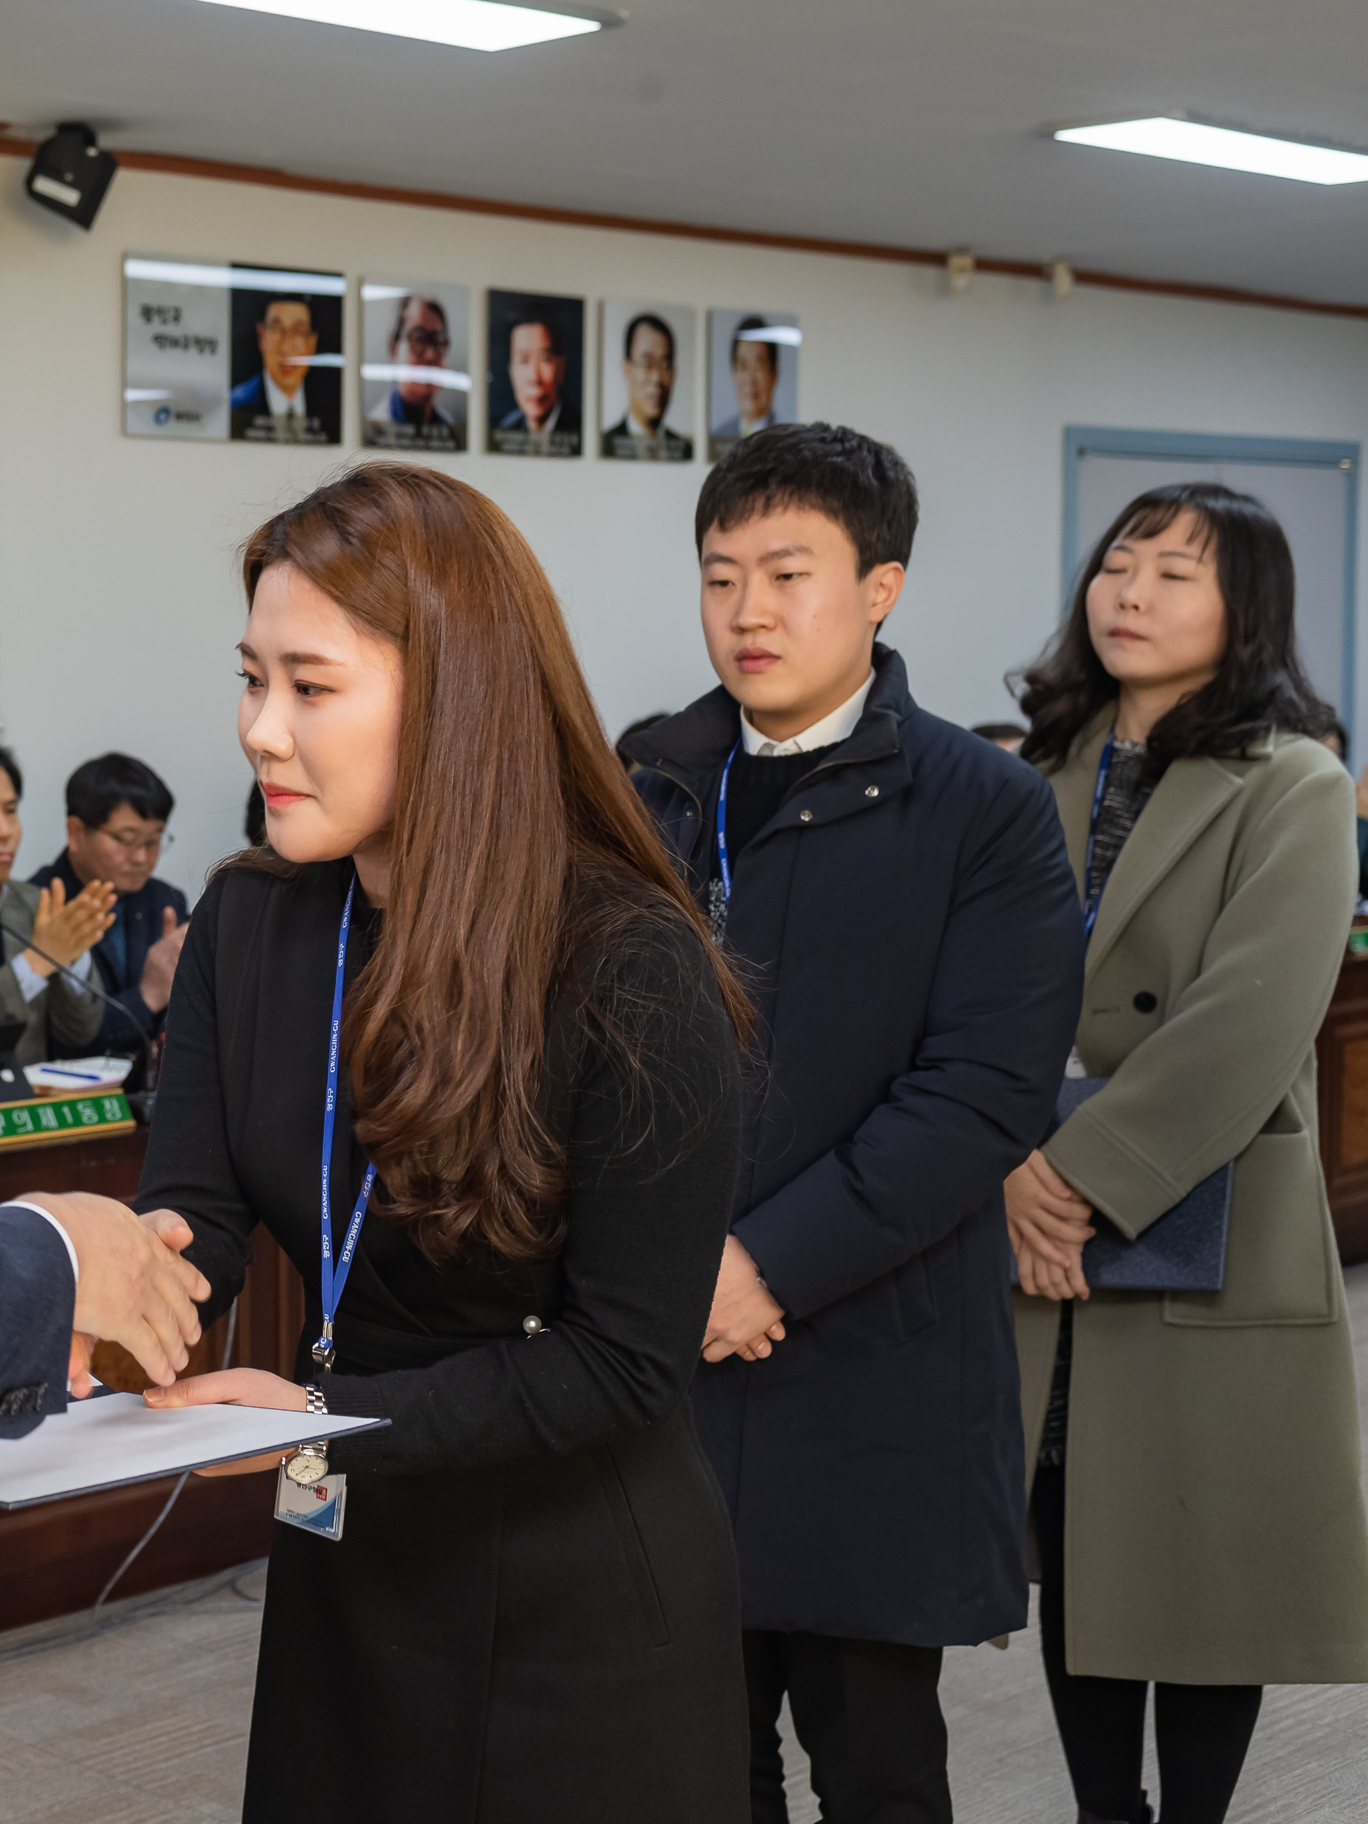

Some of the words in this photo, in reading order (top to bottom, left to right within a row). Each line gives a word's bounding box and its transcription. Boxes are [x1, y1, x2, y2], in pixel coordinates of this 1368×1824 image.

[329, 1019, 339, 1073] GWANGJIN-GU
[326, 1087, 334, 1112] 광진구
[342, 1211, 362, 1263] GWANGJIN-GU
